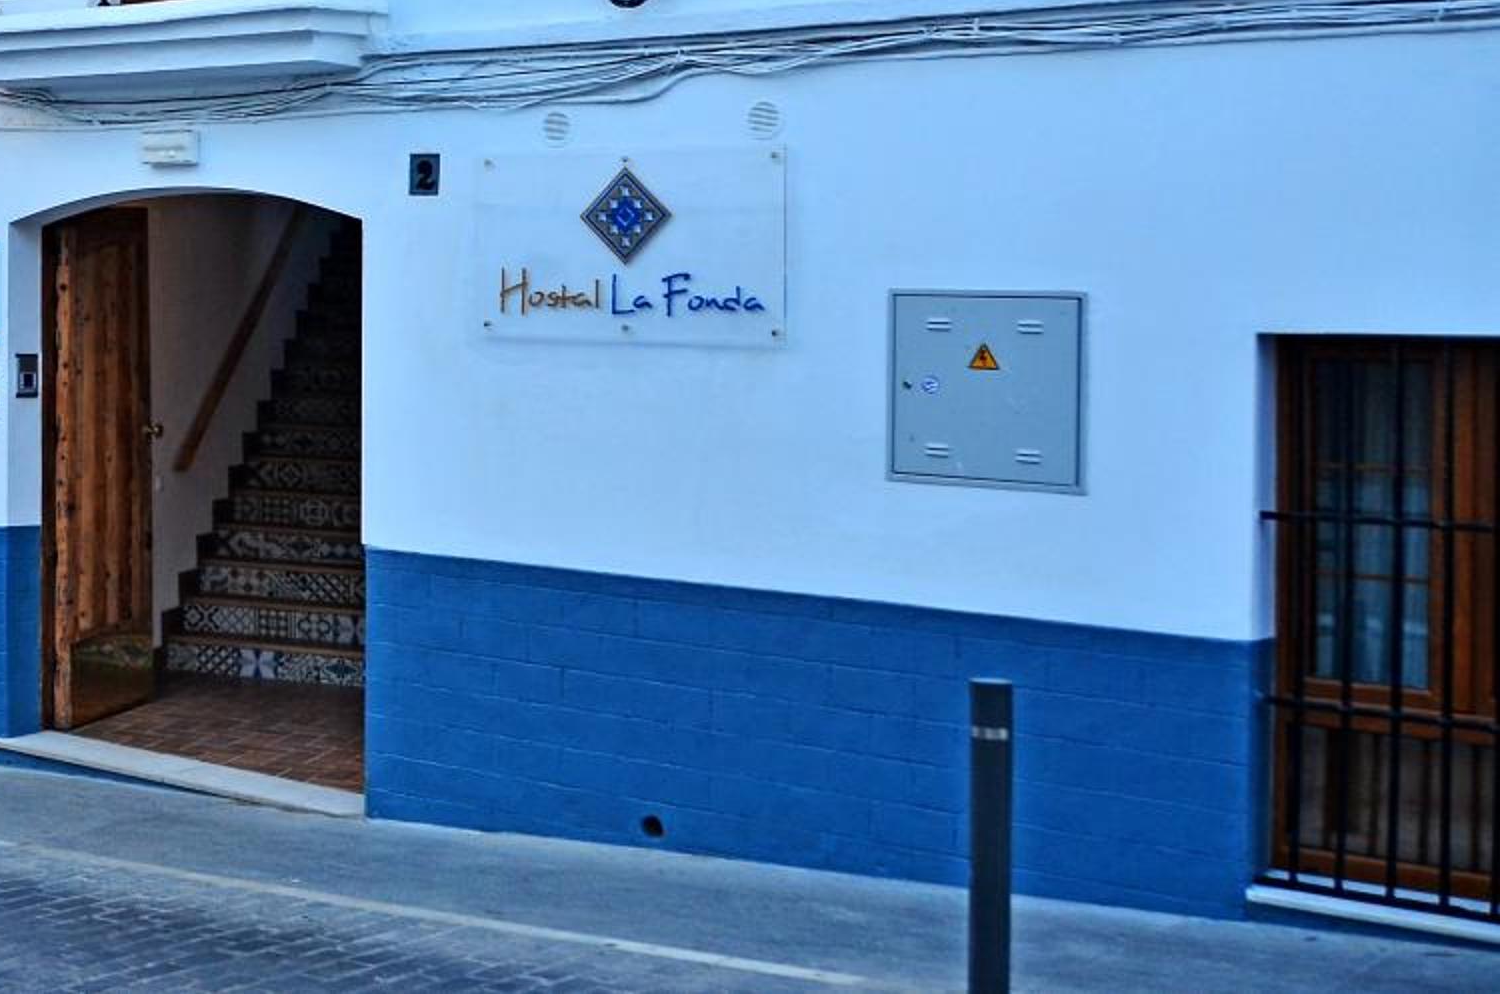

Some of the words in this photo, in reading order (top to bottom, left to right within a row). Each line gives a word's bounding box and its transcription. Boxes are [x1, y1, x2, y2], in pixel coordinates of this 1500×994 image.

[415, 159, 436, 191] 2
[500, 267, 600, 315] Hostal
[611, 273, 653, 316] La
[661, 273, 766, 317] Fonda
